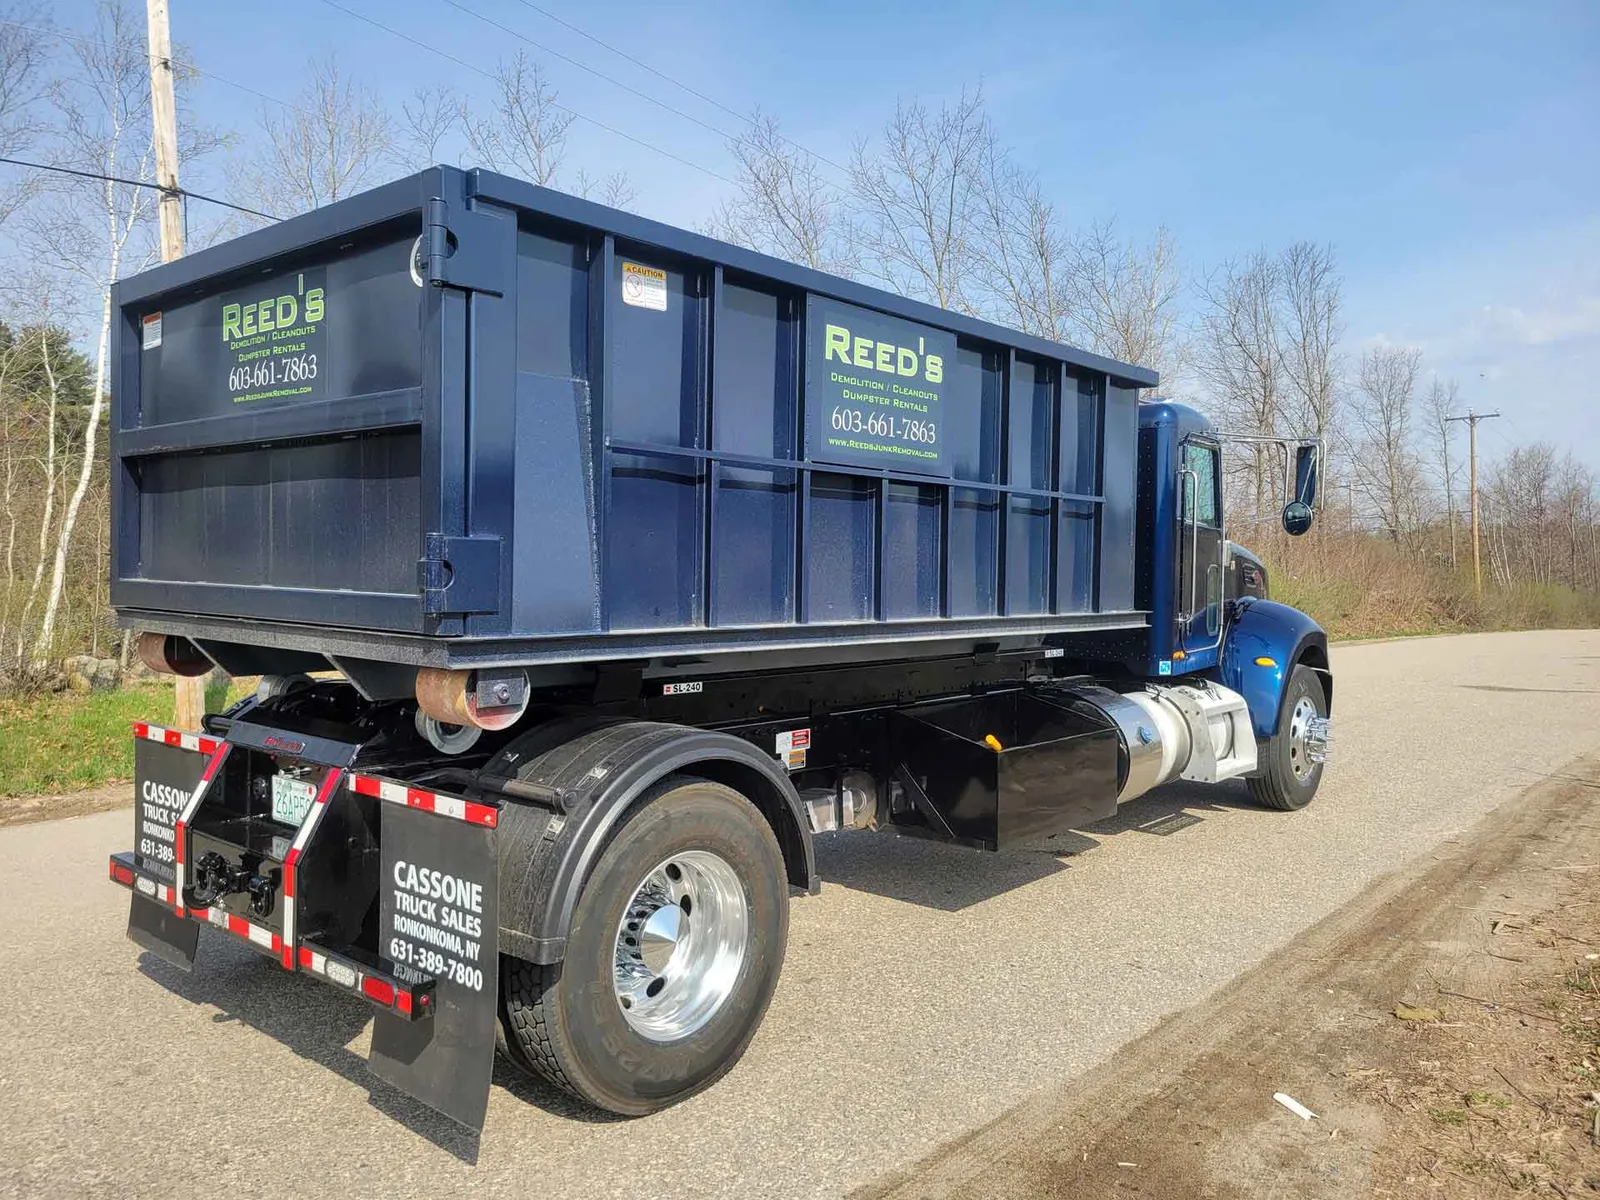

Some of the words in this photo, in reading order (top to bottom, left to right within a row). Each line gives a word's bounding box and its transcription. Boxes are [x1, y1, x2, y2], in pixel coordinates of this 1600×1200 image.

[632, 266, 663, 280] CAUTION
[223, 274, 324, 341] REED'S
[230, 335, 266, 350] DEMOLITION
[272, 325, 316, 340] CLEANOUTS
[239, 348, 270, 362] DUMPSTER
[273, 342, 306, 355] RENTALS
[825, 324, 943, 384] REED'S
[229, 353, 317, 392] 603-661-7863
[830, 372, 884, 391] DEMOLITION
[893, 384, 938, 401] CLEANOUTS
[843, 389, 890, 405] DUMPSTER
[893, 398, 928, 413] RENTALS
[831, 405, 936, 444] 603-661-7863
[673, 682, 701, 693] SL-240
[143, 780, 191, 811] CASSON
[143, 803, 169, 825] TRUCK
[394, 861, 482, 914] CASSONE
[394, 890, 437, 922] TRUCK
[441, 906, 482, 938] SALES
[394, 914, 464, 958] RONKONKOMA,
[465, 940, 480, 961] NY
[390, 938, 483, 991] 631-389-7800
